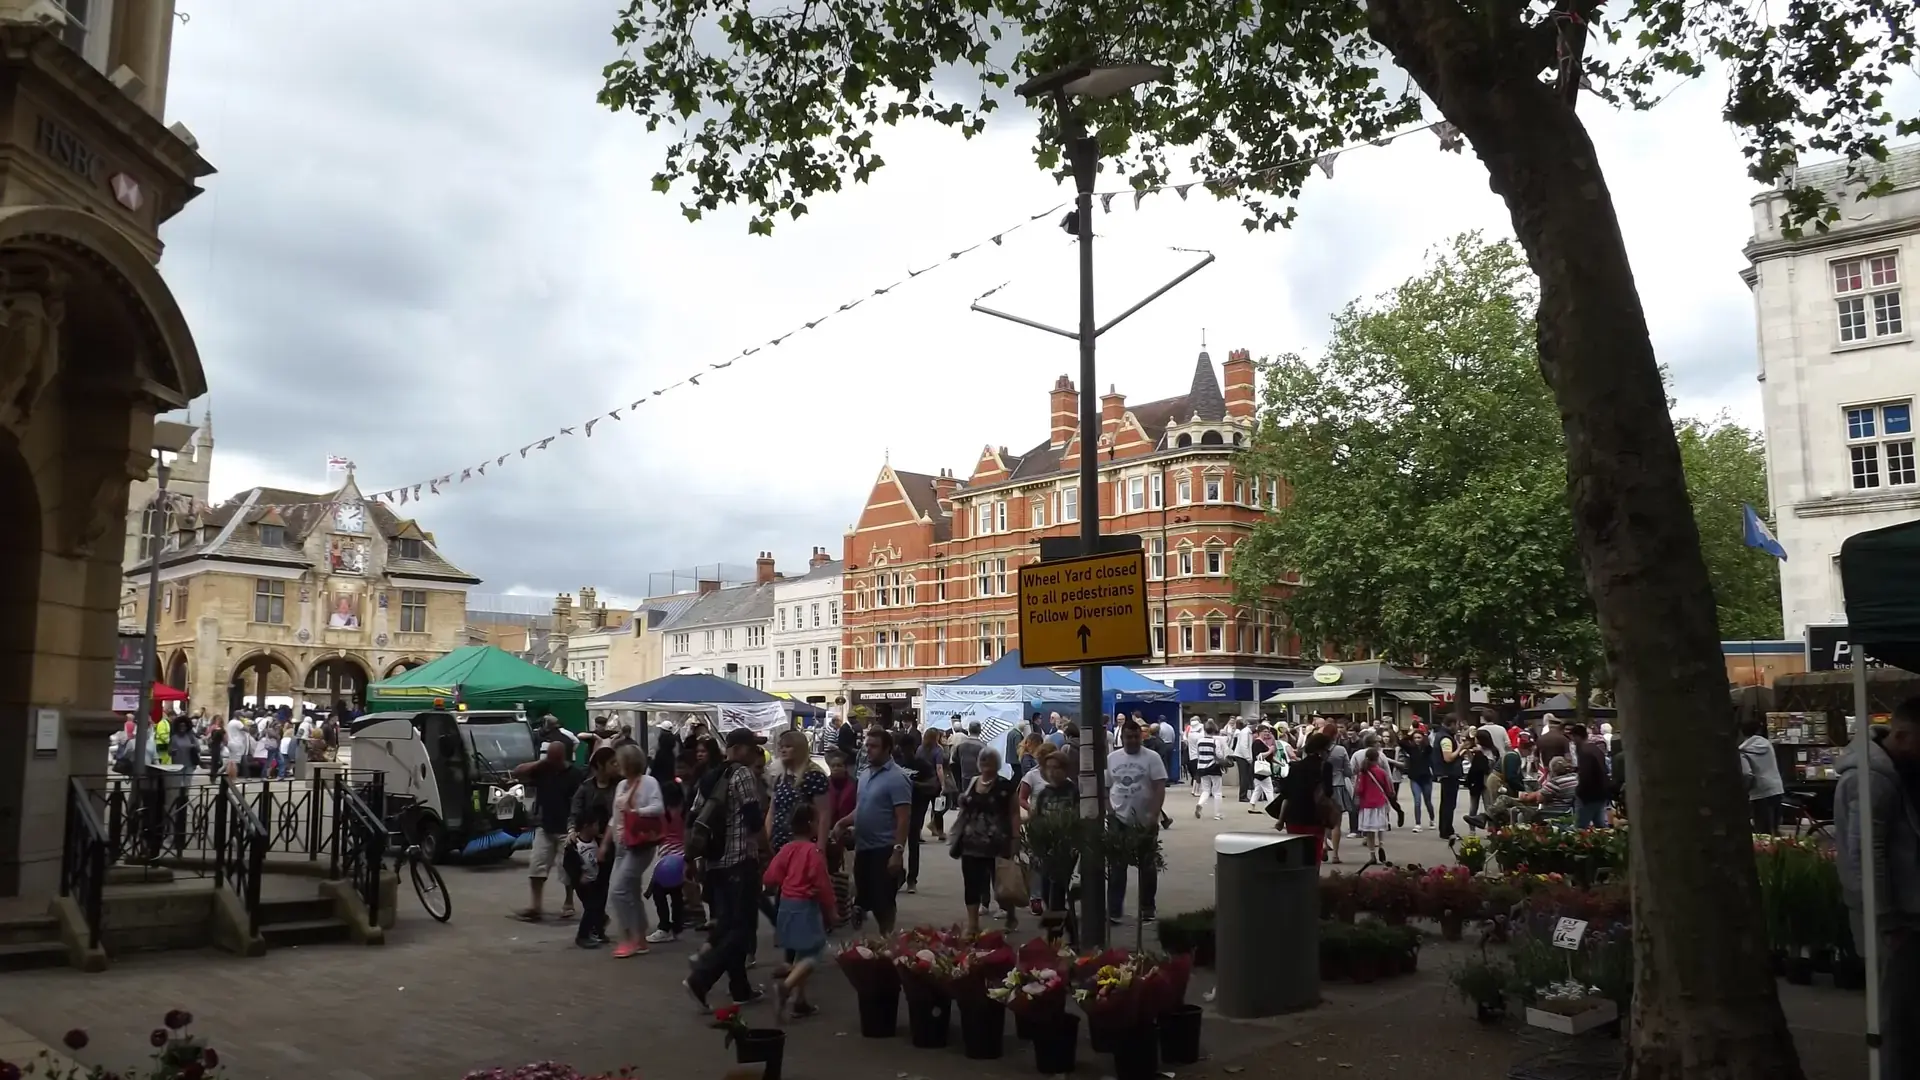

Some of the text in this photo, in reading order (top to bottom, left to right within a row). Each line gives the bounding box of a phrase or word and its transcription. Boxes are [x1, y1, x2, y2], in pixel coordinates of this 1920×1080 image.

[40, 117, 104, 186] HSBC
[1024, 561, 1137, 587] Wheel Yard closed
[1027, 583, 1134, 605] to all pedestrians
[1029, 603, 1133, 624] Follow Diversion
